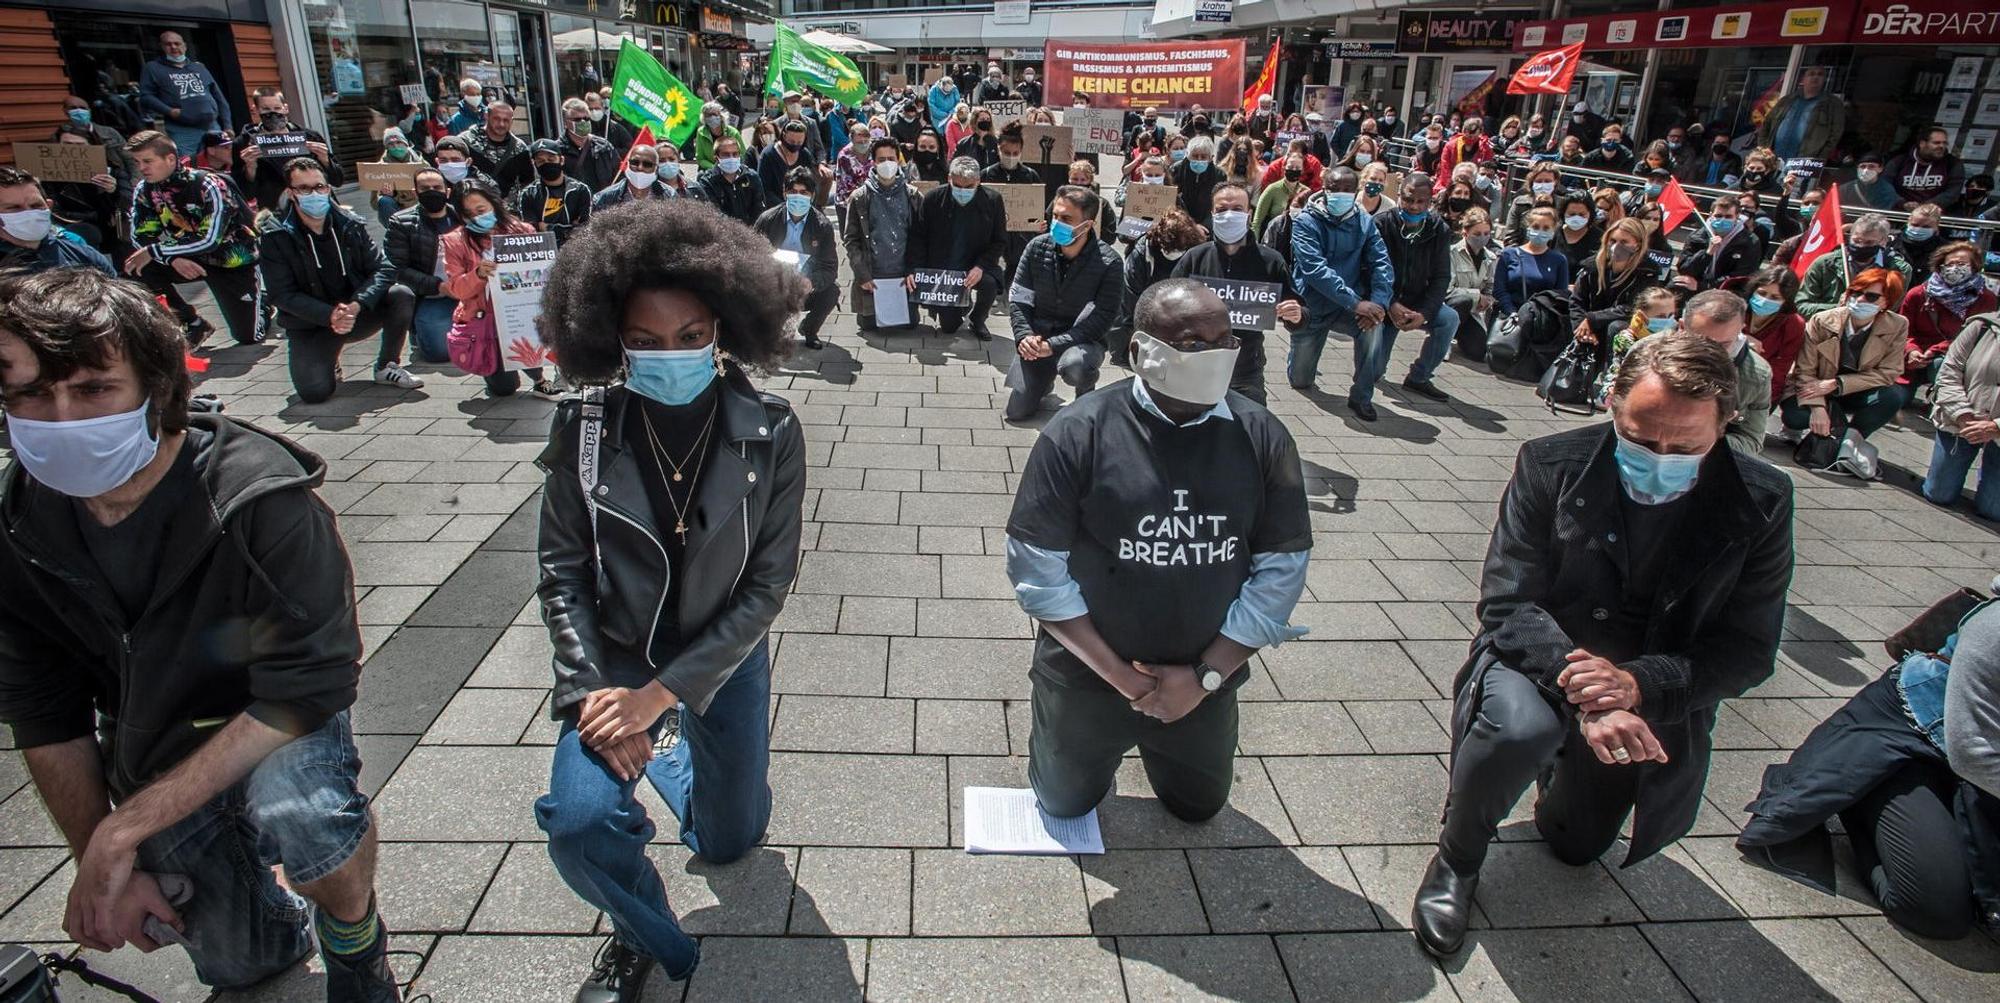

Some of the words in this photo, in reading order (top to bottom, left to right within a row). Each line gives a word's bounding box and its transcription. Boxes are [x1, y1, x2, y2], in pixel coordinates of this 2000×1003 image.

[1430, 20, 1497, 38] BEAUTY
[1056, 50, 1072, 59] GIB
[1073, 51, 1169, 61] ANTIKOMMUNISMUS,
[1170, 49, 1231, 60] FASCHISMUS,
[1073, 63, 1124, 73] RASSISMUS
[1126, 66, 1133, 74] &
[1135, 63, 1213, 73] ANTISEMITISMUS
[628, 78, 664, 105] BÜNDNIS
[1073, 76, 1127, 94] KEINE
[1131, 76, 1212, 94] CHANCE!
[639, 97, 668, 122] GRÜNEN
[984, 101, 1027, 115] RESPECT
[256, 136, 282, 145] Black
[283, 134, 306, 143] lives
[1090, 127, 1119, 142] END
[38, 145, 89, 159] BLACK
[267, 147, 300, 155] matter
[41, 160, 91, 170] LIVES
[1804, 160, 1824, 168] lives
[503, 235, 543, 246] matter
[496, 252, 523, 264] lives
[525, 250, 556, 262] Black
[914, 272, 941, 285] Black
[920, 291, 958, 302] matter
[1239, 286, 1277, 303] lives
[1229, 311, 1260, 325] tter
[1173, 489, 1189, 512] I
[1137, 514, 1228, 539] CAN'T
[1118, 536, 1239, 566] BREATHE
